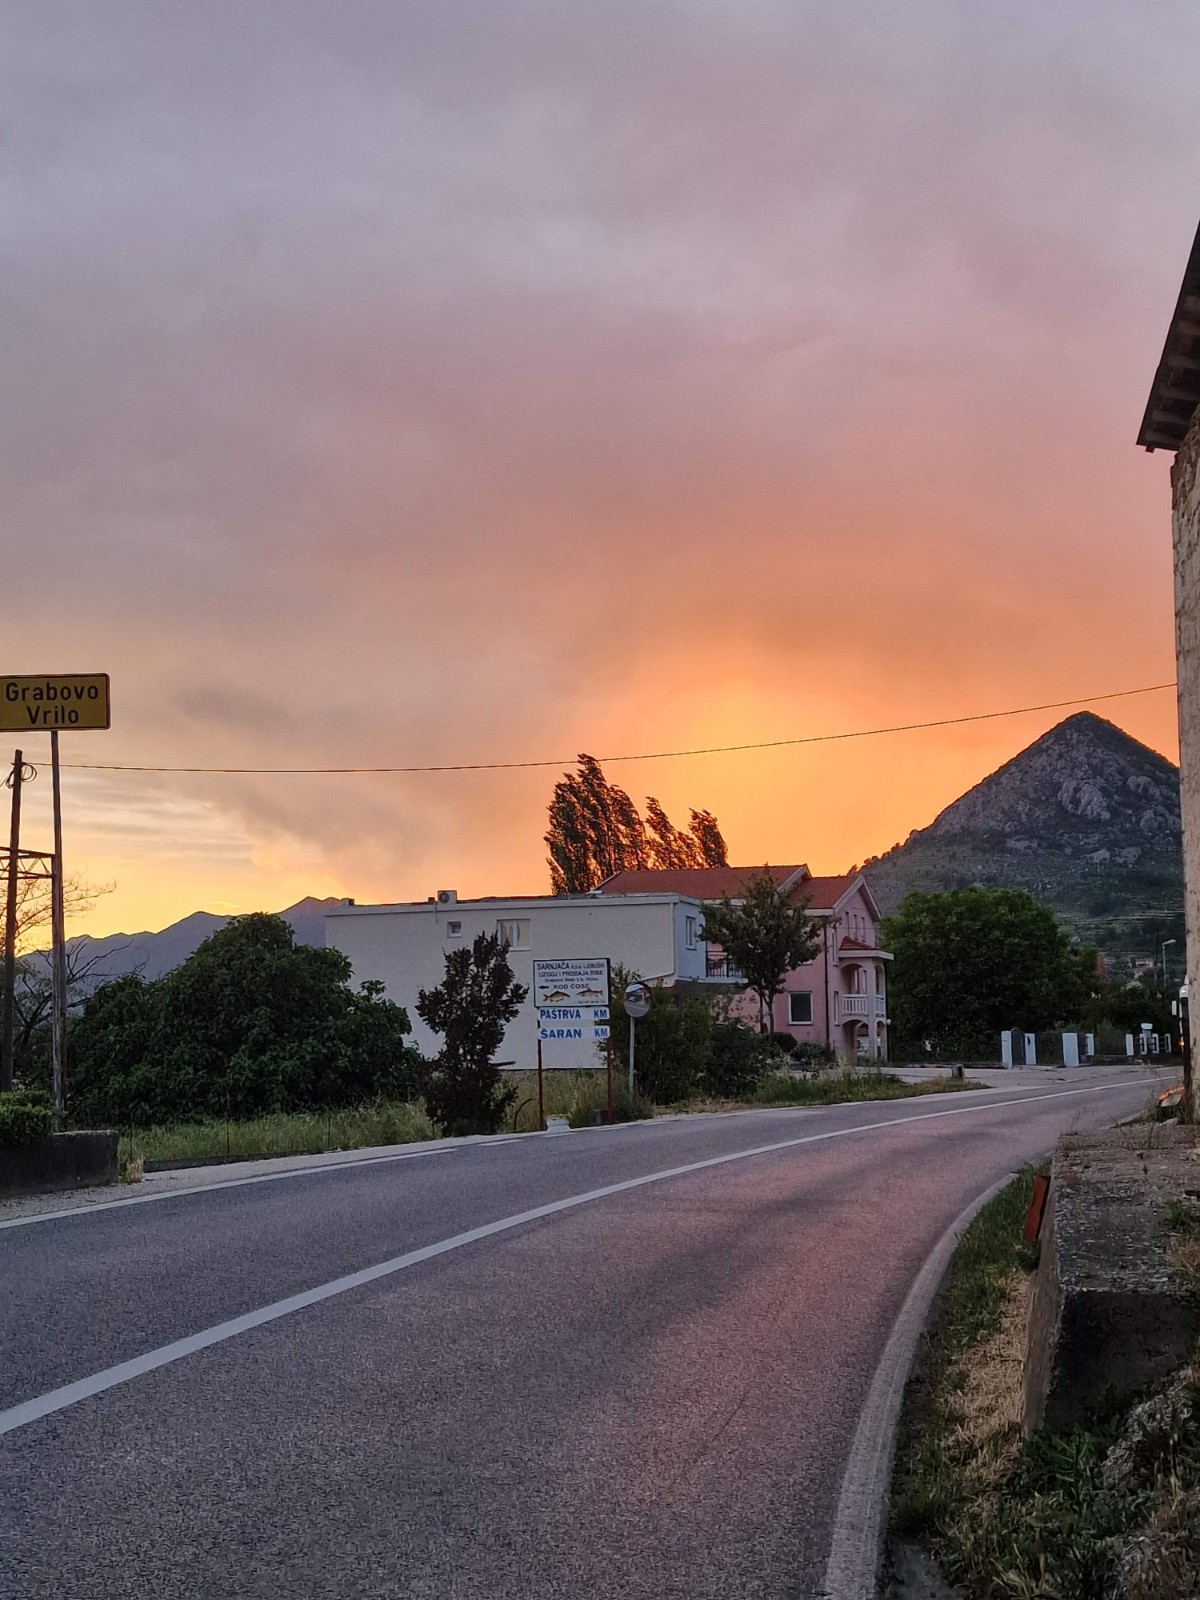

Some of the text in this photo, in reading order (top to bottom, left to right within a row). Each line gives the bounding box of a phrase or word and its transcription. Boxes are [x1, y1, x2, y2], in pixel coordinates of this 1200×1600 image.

[6, 682, 98, 701] Grabovo
[26, 705, 79, 724] Vrilo
[594, 1009, 607, 1018] KM
[595, 1028, 608, 1037] KM
